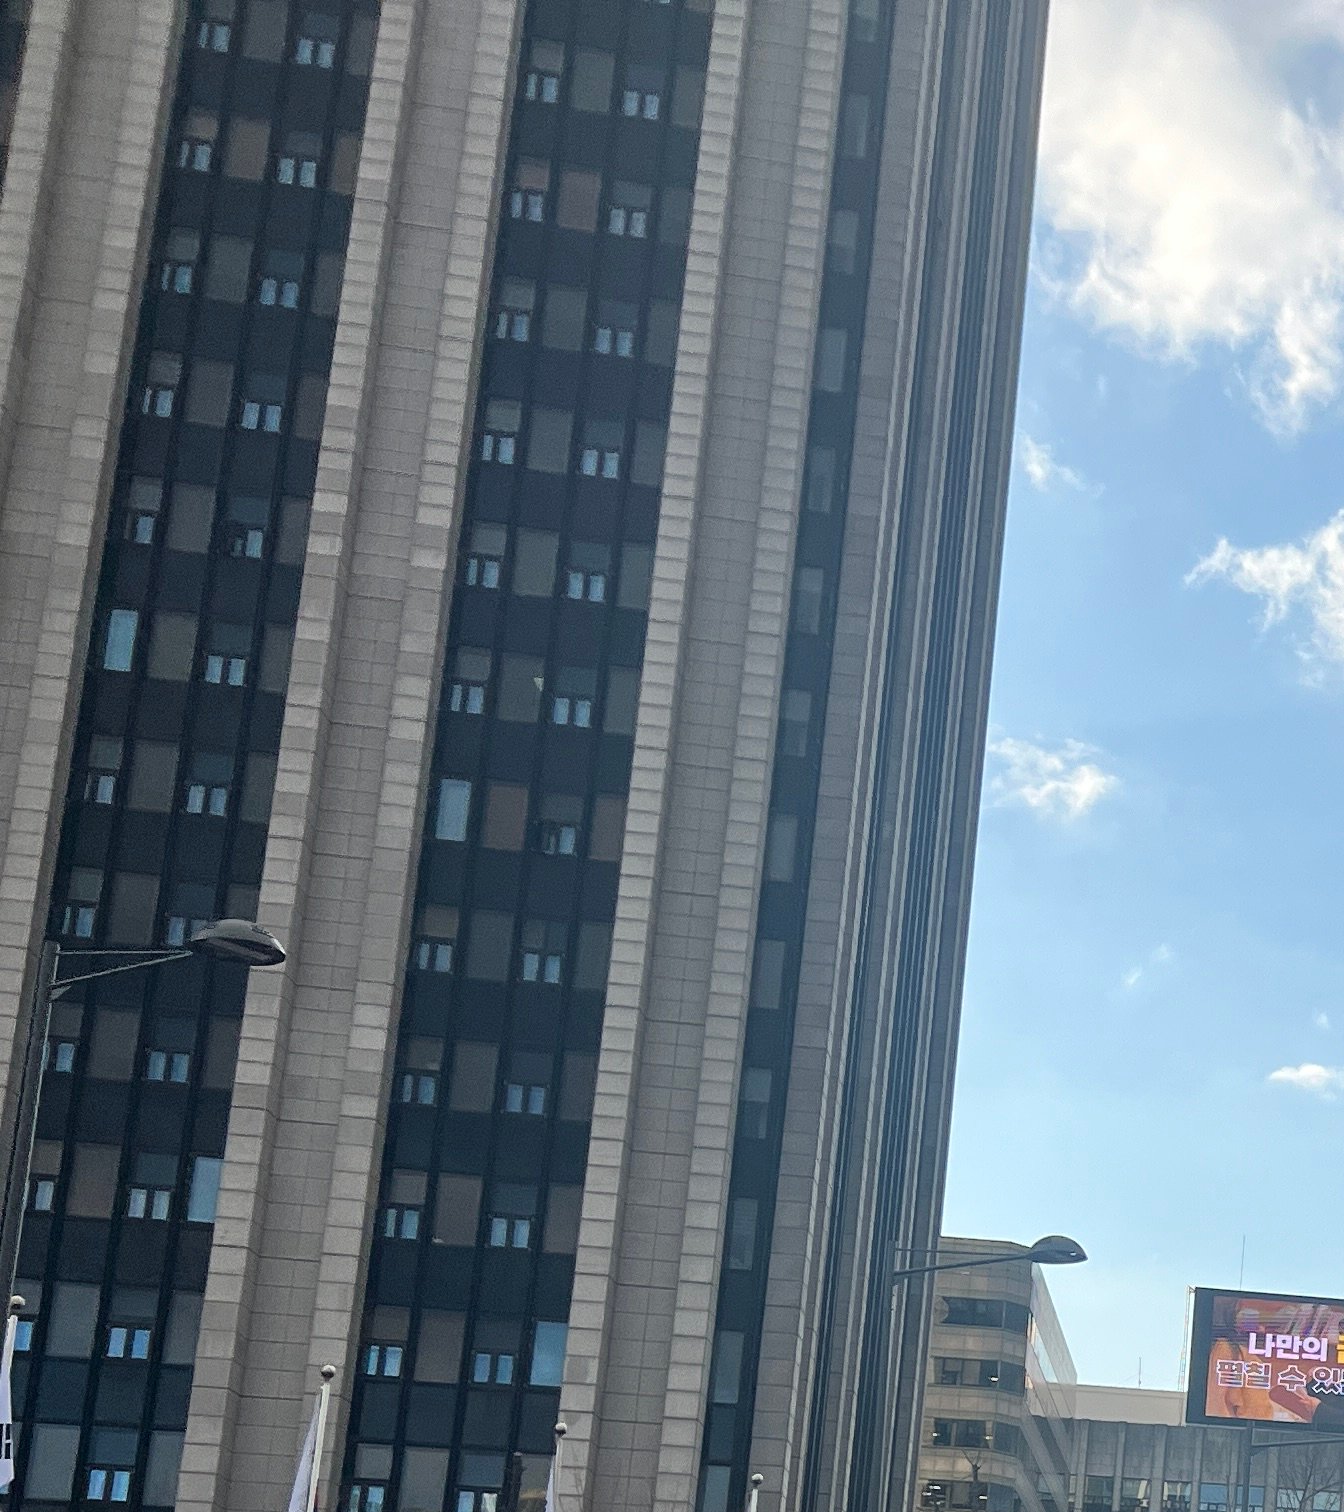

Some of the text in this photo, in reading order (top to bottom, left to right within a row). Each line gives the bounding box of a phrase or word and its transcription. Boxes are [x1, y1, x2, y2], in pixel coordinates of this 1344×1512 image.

[1248, 1332, 1328, 1362] 나만의
[1216, 1359, 1272, 1390] 펼칠
[1278, 1365, 1306, 1391] 수
